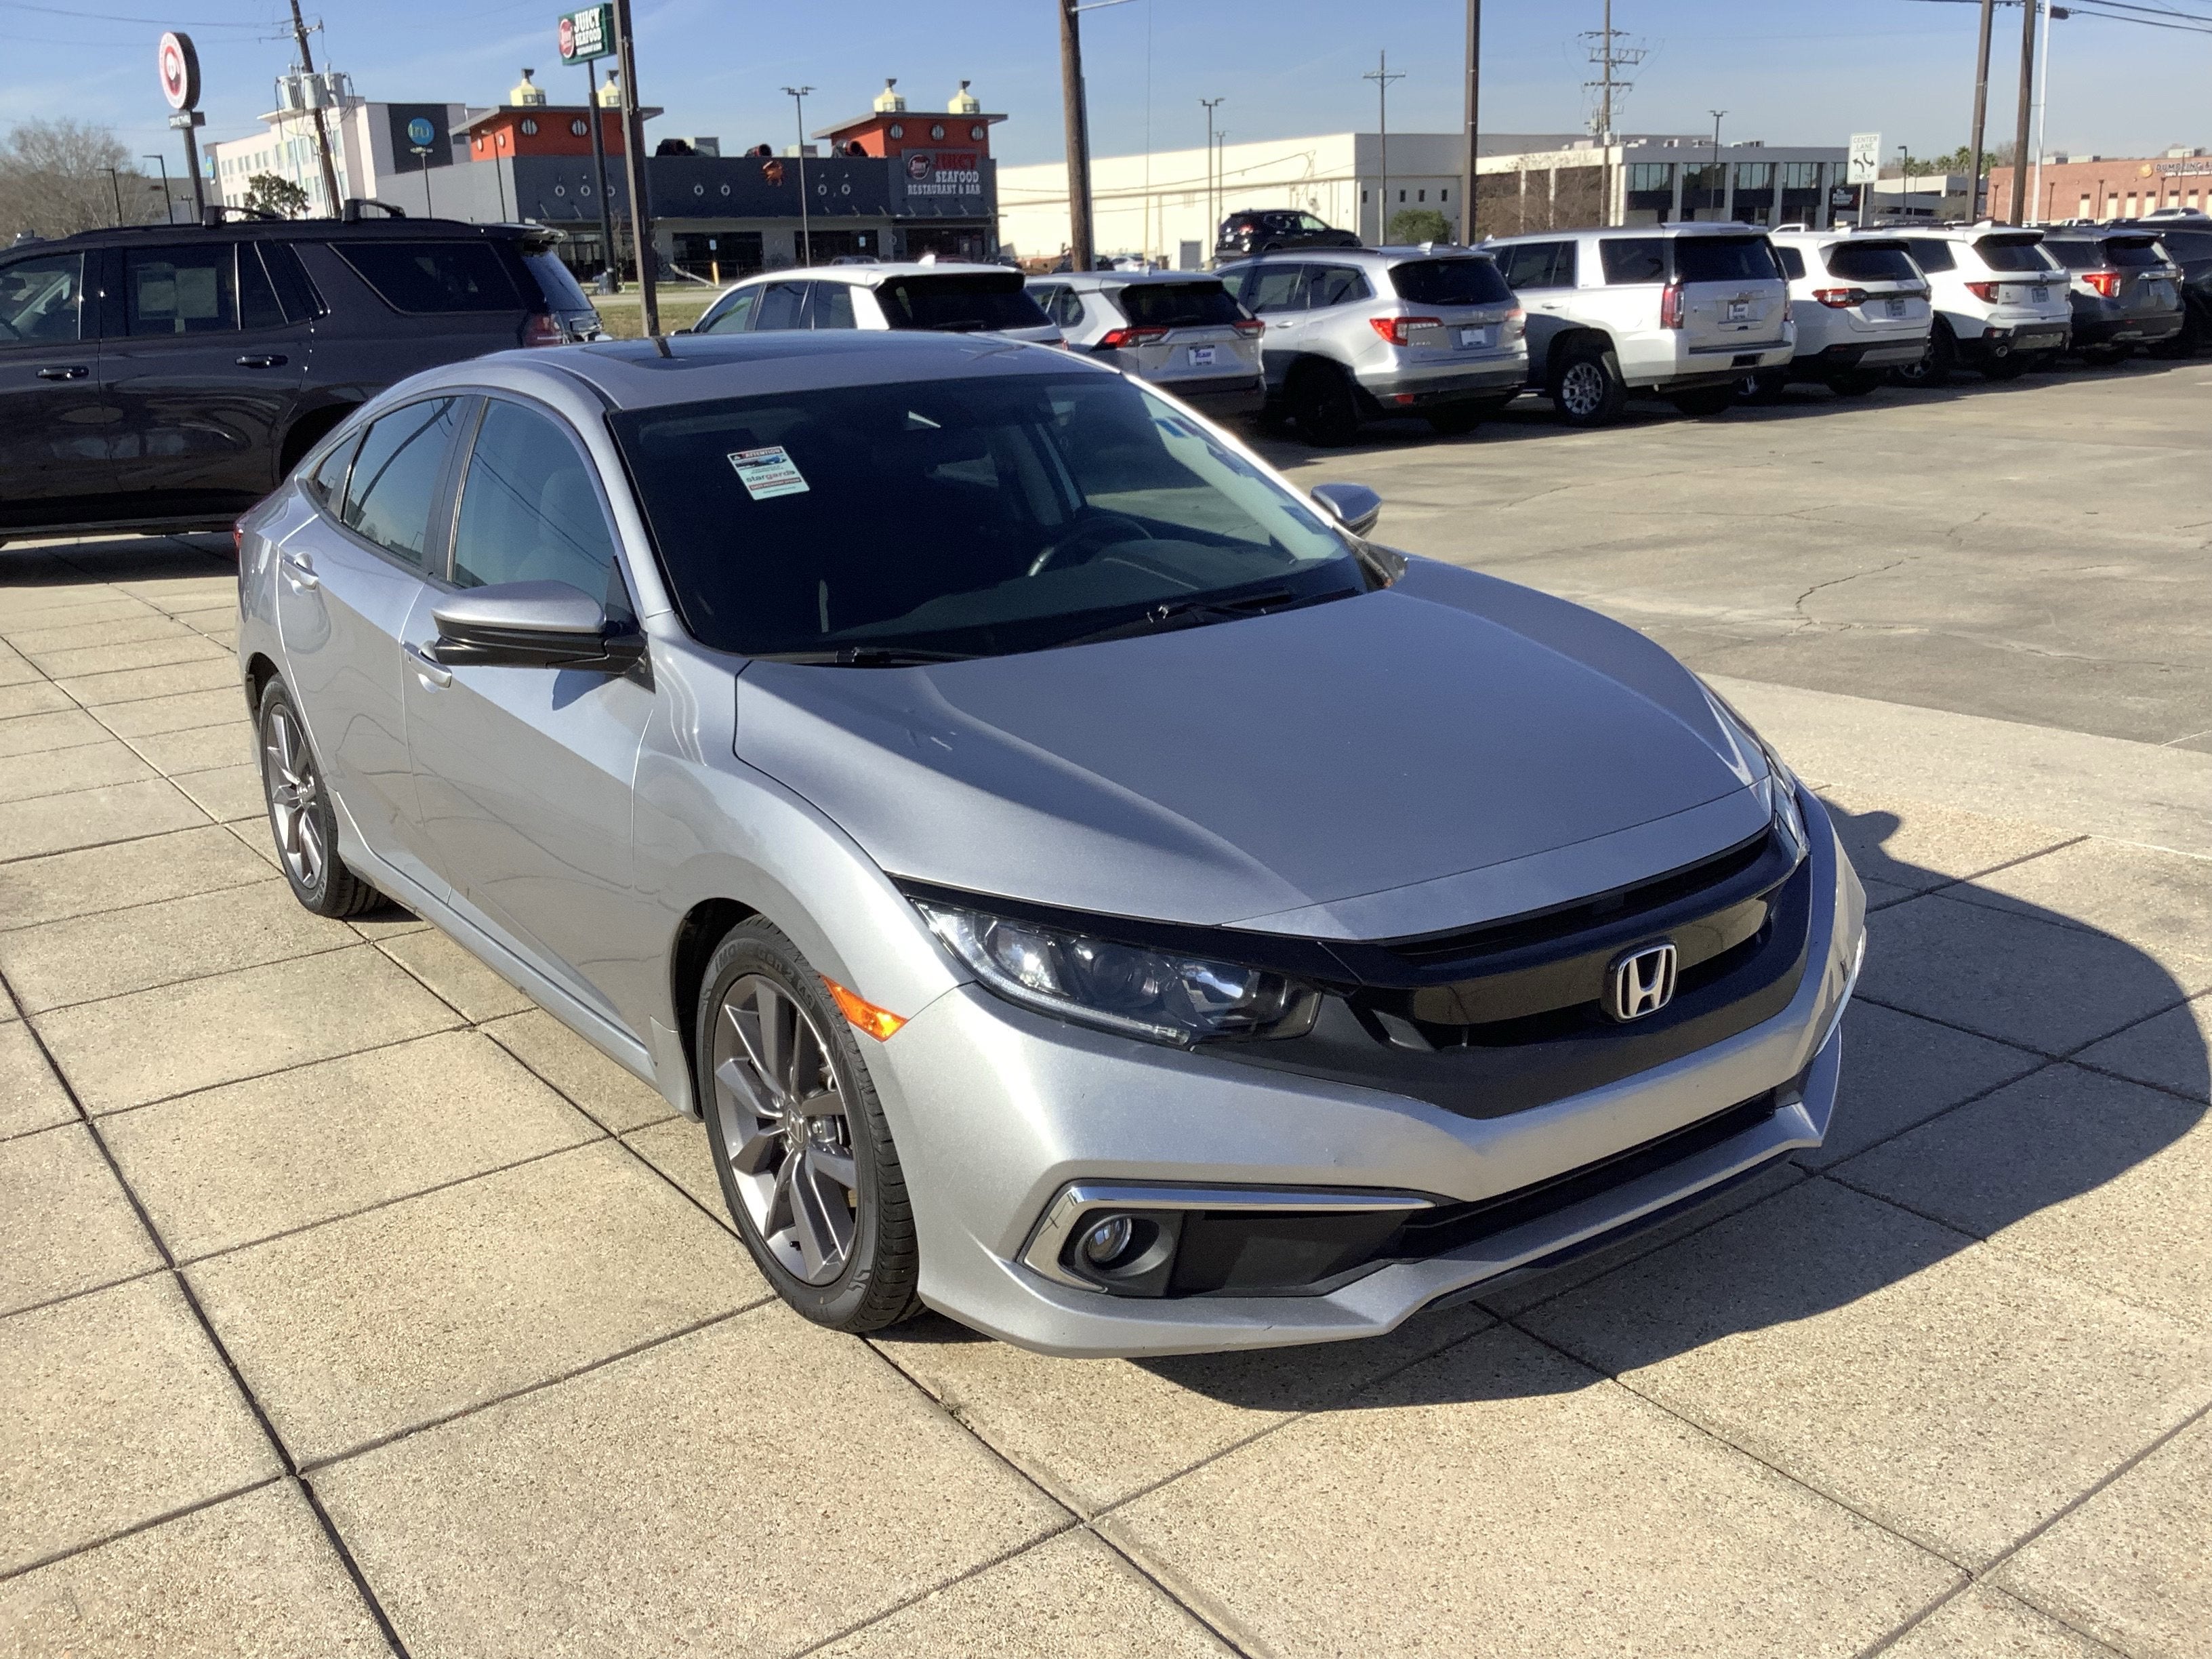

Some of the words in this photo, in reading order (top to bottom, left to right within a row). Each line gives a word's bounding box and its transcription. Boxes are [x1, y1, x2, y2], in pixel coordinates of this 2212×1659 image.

[574, 7, 600, 33] JUICY
[575, 27, 602, 47] SEAFOOD
[933, 154, 976, 170] JUICY
[935, 171, 979, 183] SEAFOOD
[908, 184, 956, 195] RESTAURANT
[958, 184, 964, 194] &
[965, 184, 981, 195] BAR
[745, 449, 781, 458] ATTENTION
